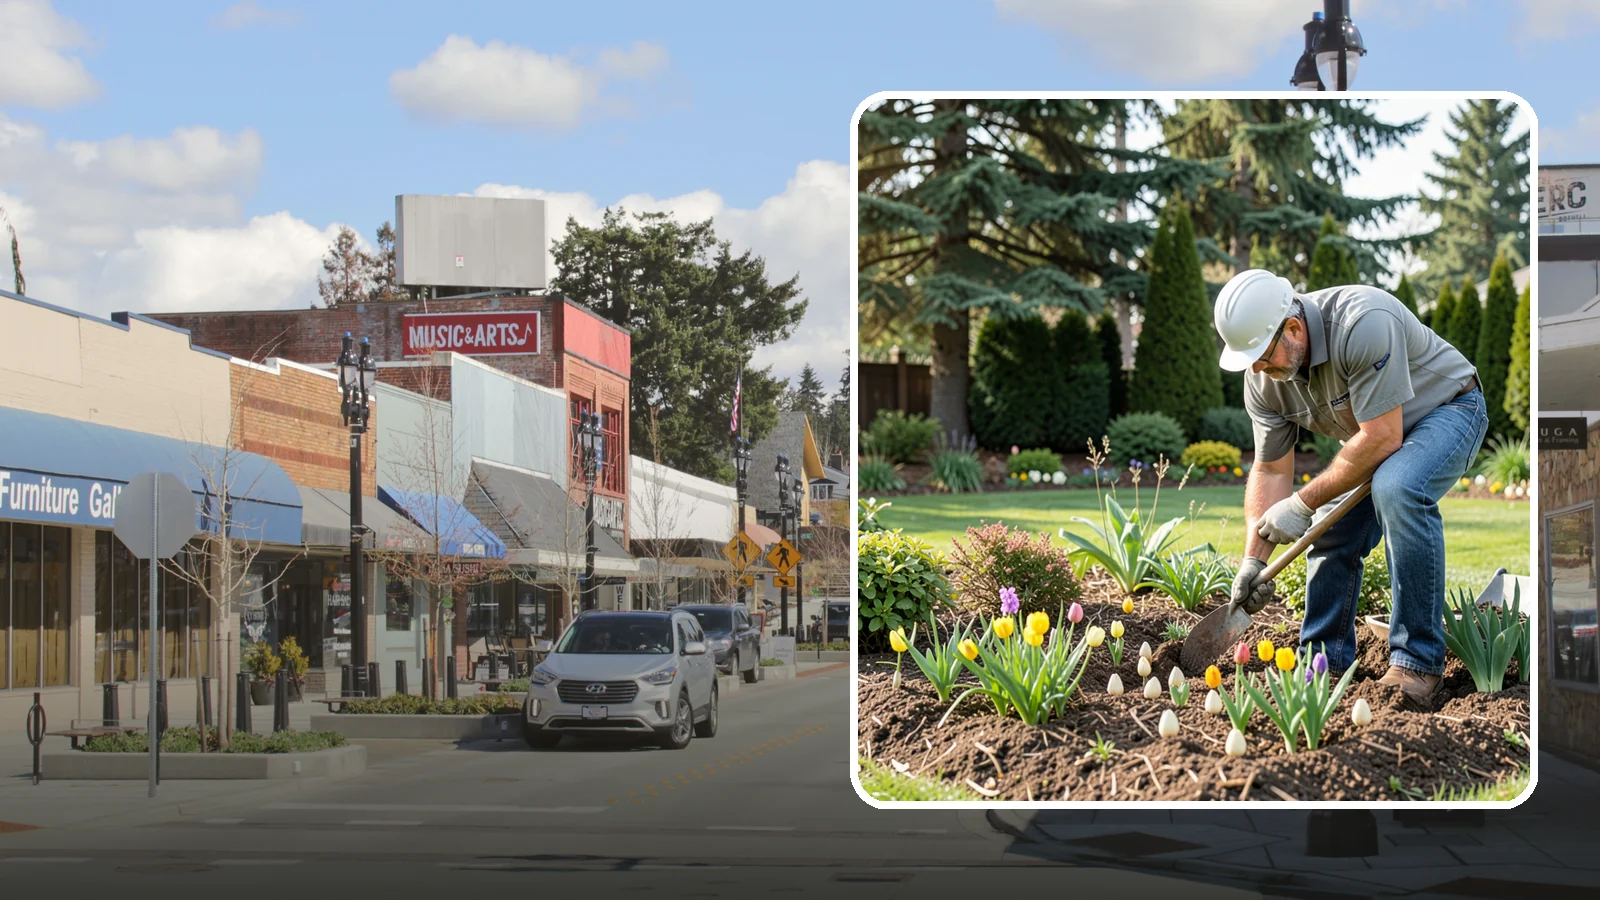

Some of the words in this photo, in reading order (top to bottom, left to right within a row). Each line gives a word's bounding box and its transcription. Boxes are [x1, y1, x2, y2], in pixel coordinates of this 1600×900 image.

[408, 323, 520, 349] MUSIC&ARTS
[0, 471, 79, 515] Furniture
[89, 482, 122, 519] Gal
